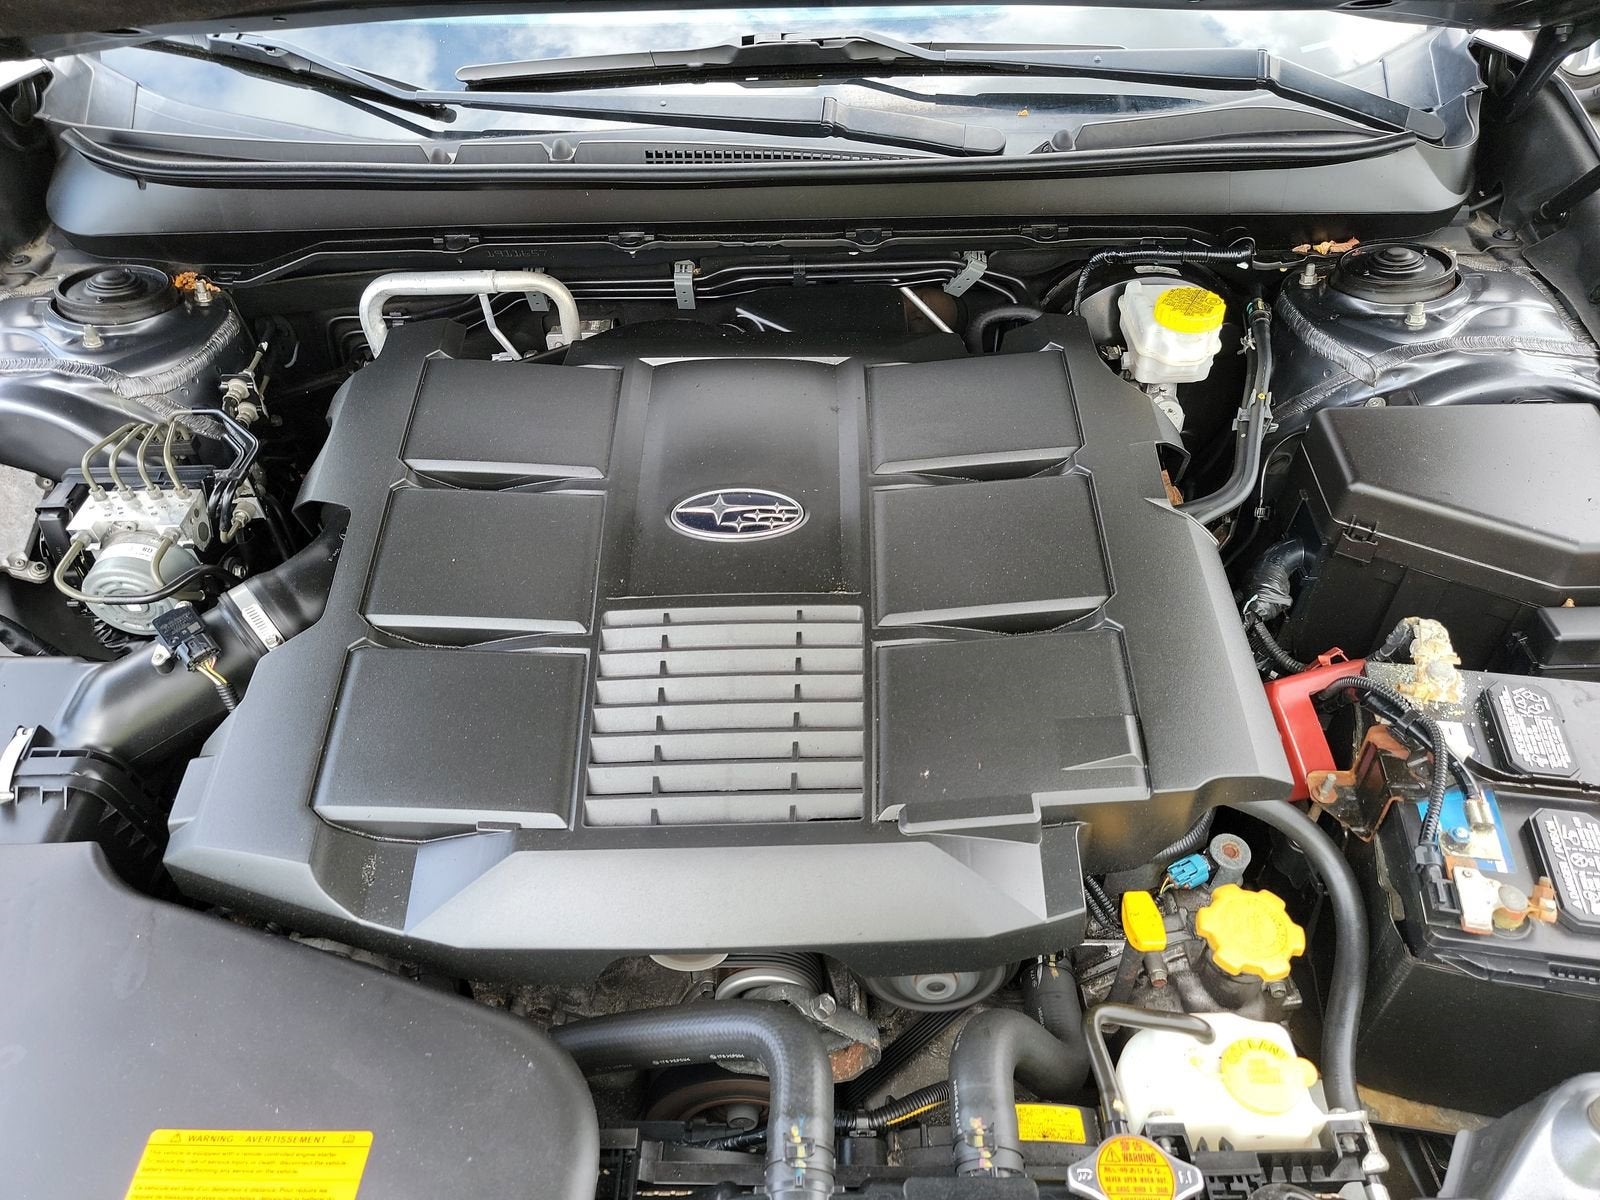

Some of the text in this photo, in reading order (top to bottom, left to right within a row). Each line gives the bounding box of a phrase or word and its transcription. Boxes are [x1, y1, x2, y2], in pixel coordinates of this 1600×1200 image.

[187, 1135, 327, 1144] WARNING AVERTISSEMENT
[1123, 1153, 1157, 1164] WARNING
